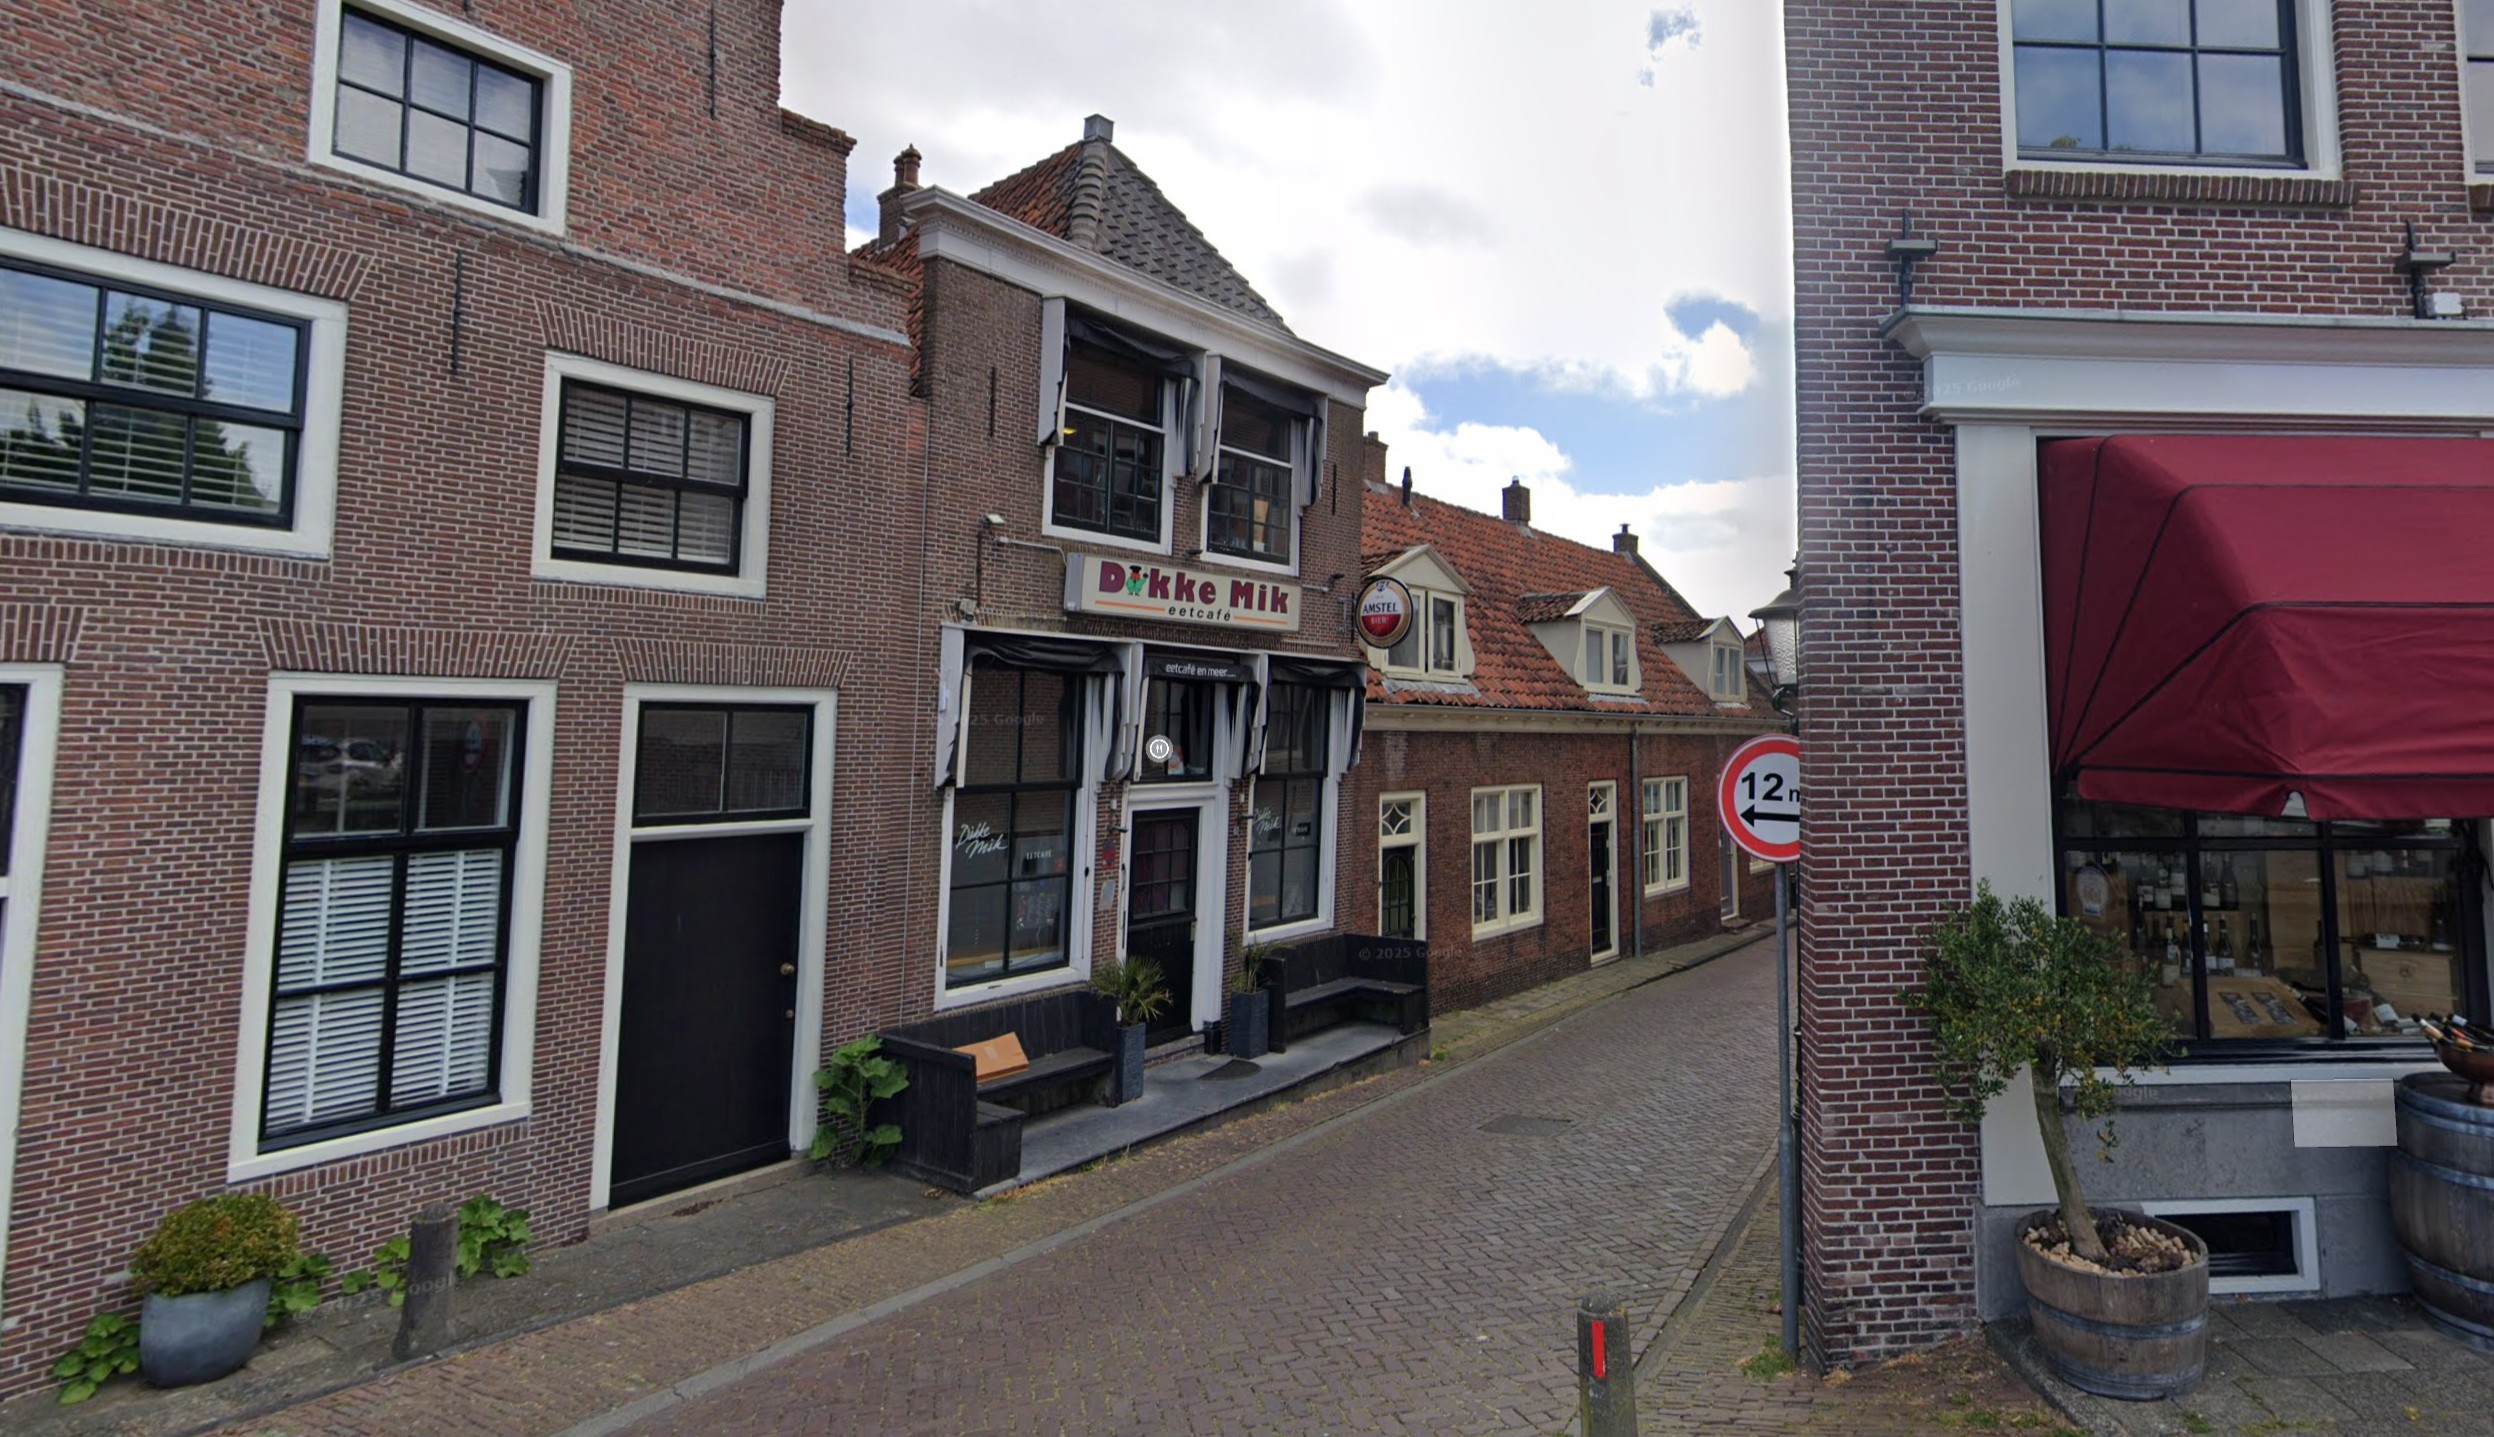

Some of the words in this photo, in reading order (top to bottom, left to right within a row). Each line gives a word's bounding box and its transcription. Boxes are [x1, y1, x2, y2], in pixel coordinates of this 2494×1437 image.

[1229, 579, 1289, 614] Mik
[1168, 605, 1231, 622] eetcafé
[1362, 602, 1399, 615] AMSTEL
[1165, 662, 1195, 676] eetcafé
[1196, 667, 1207, 676] en
[955, 822, 991, 849] Dikke
[965, 833, 1008, 859] Mik
